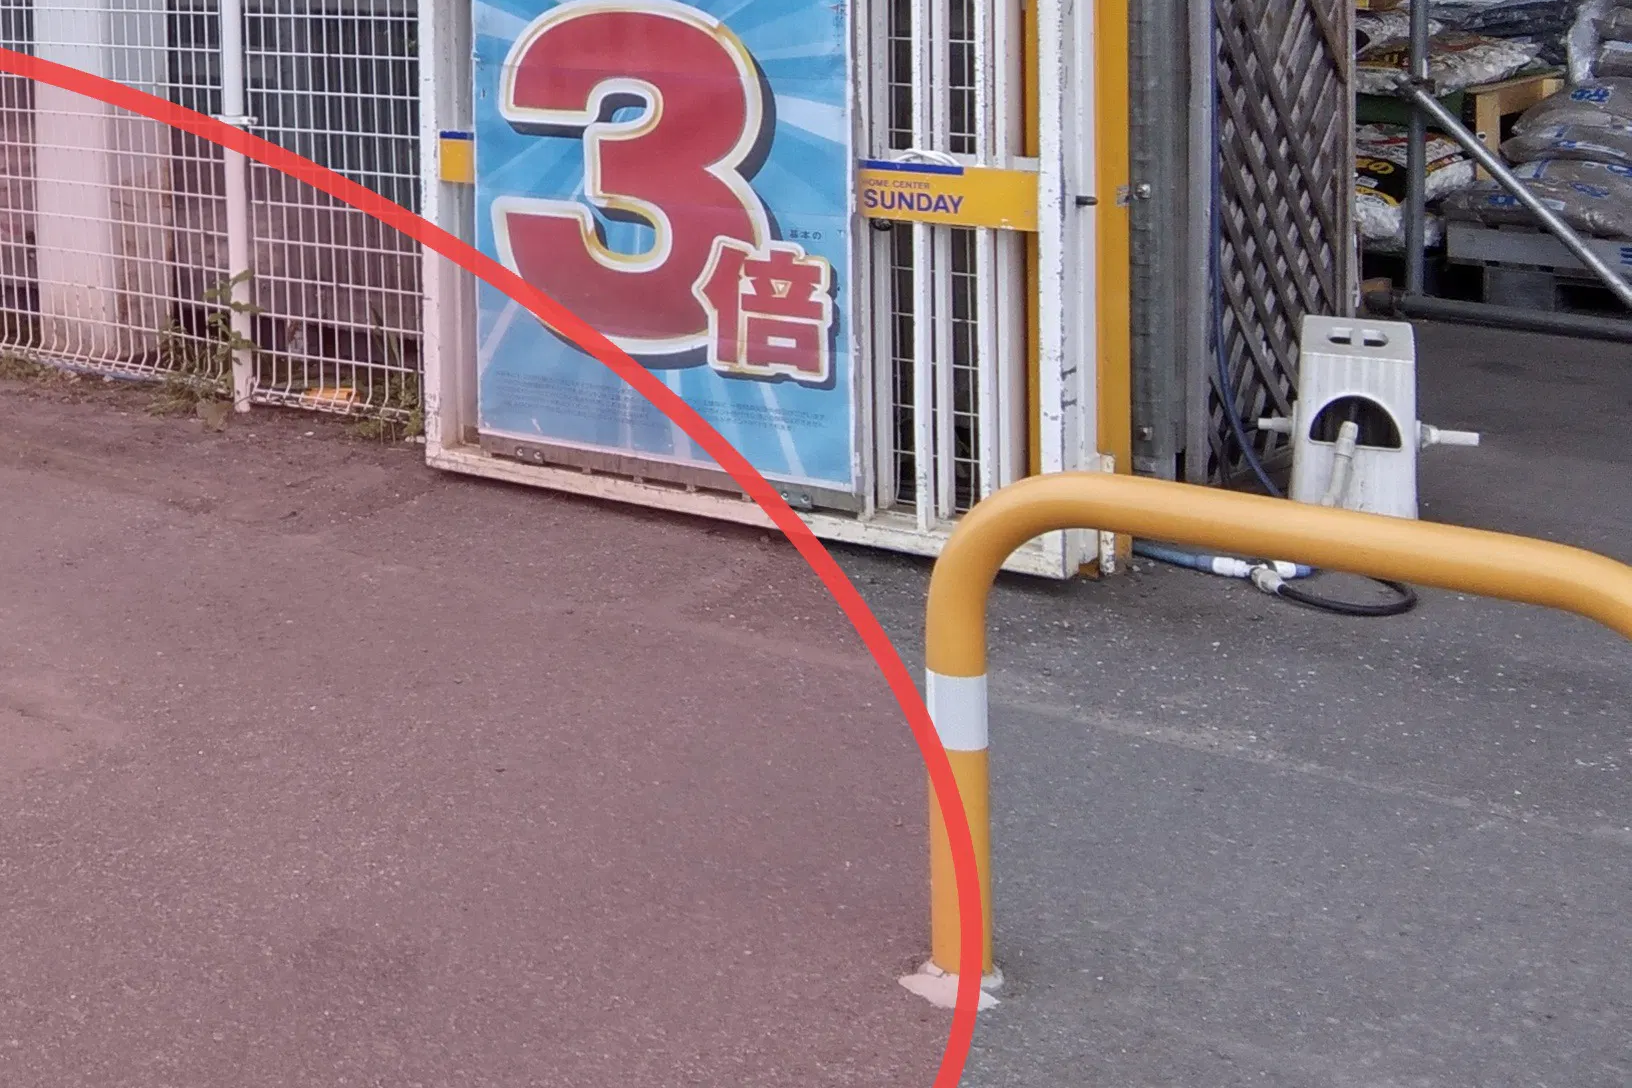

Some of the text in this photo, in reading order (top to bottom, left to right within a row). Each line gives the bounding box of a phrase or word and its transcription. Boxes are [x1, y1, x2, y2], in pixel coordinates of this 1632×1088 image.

[892, 179, 930, 190] CENTER
[863, 188, 965, 214] SUNDAY
[789, 229, 822, 240] 基本の
